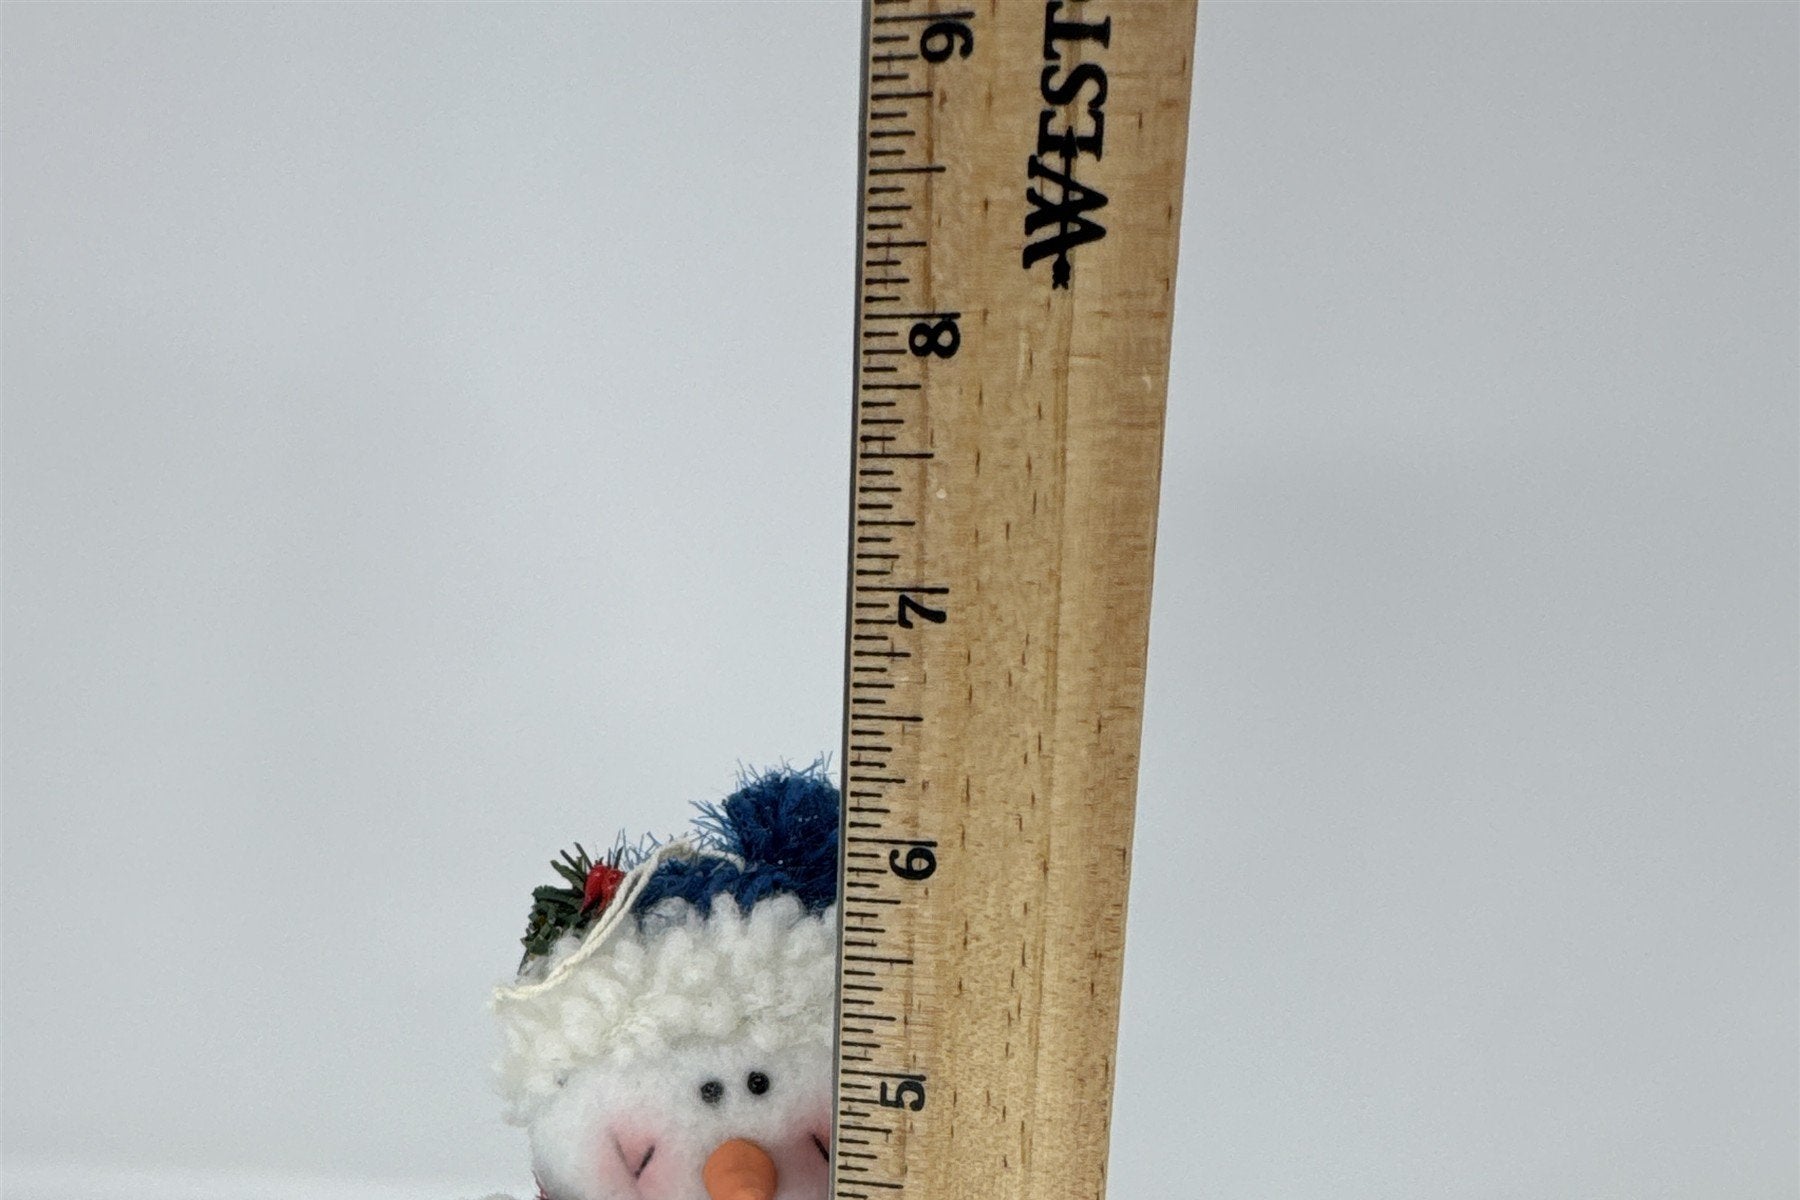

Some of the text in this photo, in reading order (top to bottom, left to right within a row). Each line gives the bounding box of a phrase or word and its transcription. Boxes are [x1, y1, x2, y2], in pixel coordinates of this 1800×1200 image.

[919, 22, 975, 64] 9
[1022, 0, 1112, 270] WEST
[908, 320, 962, 360] 8
[898, 594, 948, 630] 7
[889, 846, 938, 881] 6
[880, 1081, 926, 1112] 5
